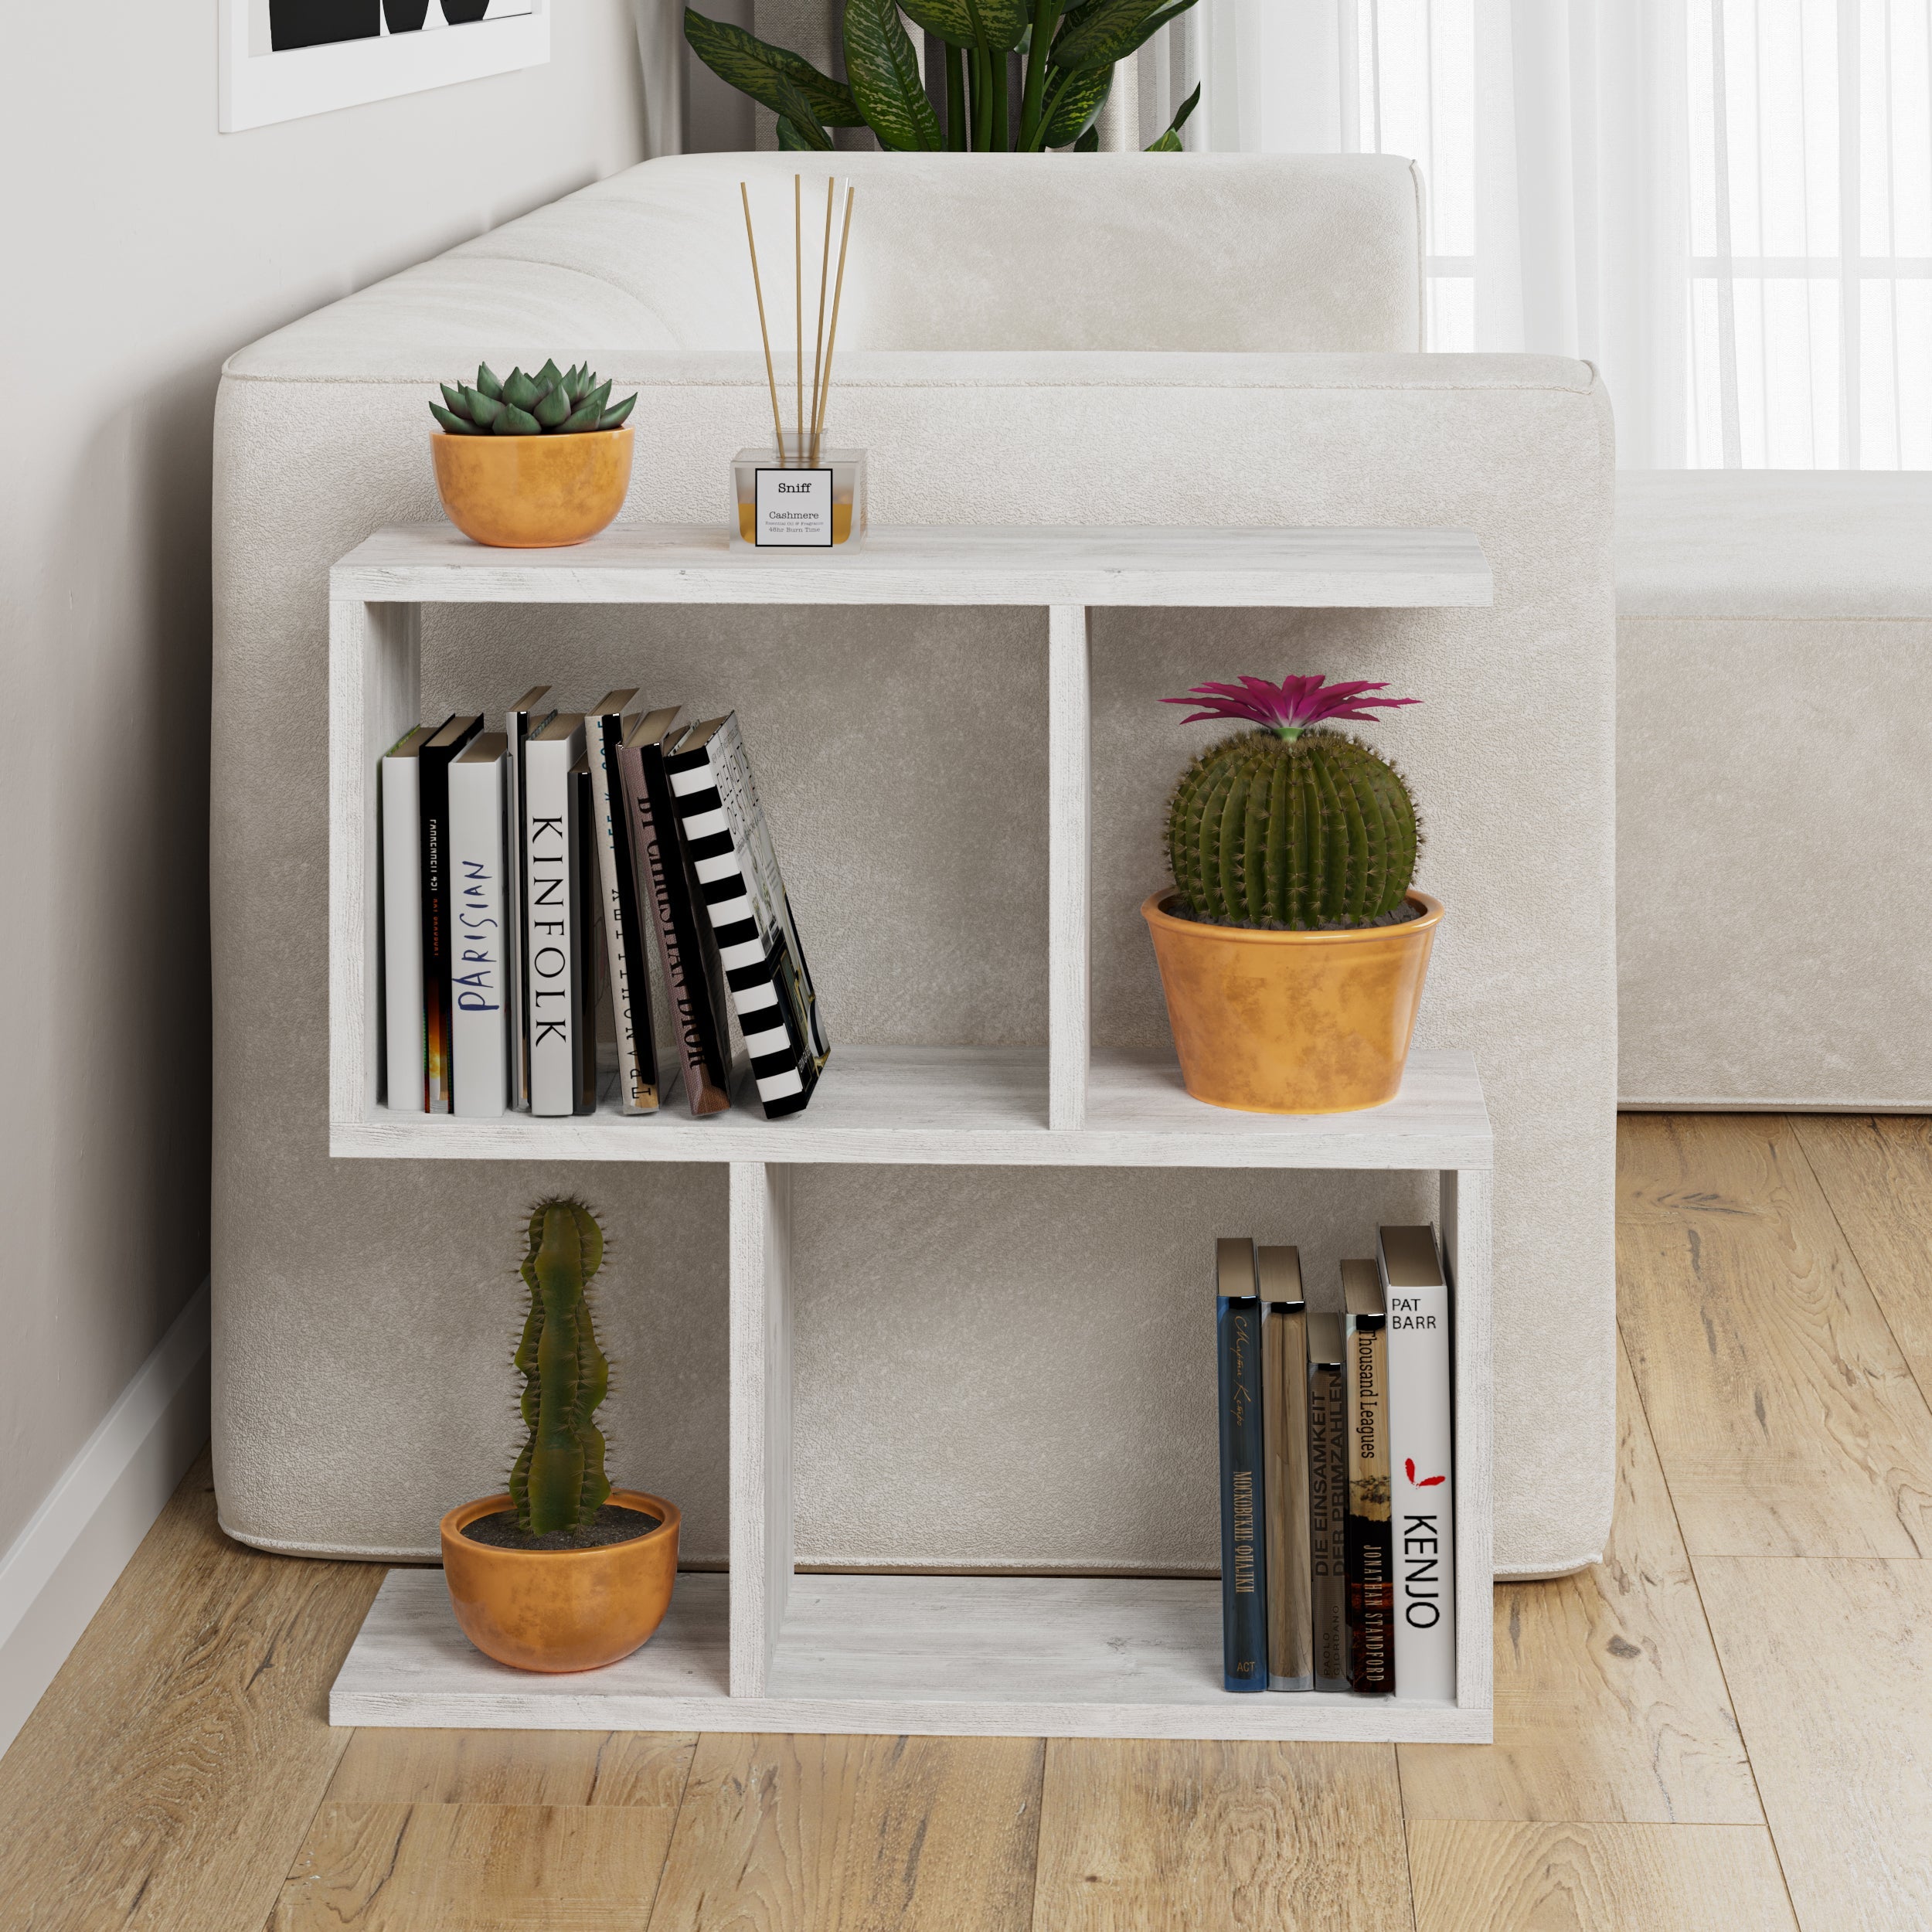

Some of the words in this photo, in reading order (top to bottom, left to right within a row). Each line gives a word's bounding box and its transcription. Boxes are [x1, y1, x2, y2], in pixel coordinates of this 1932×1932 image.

[769, 511, 819, 519] Cashmere
[778, 482, 812, 493] Sniff
[451, 860, 499, 1012] PARISIAN
[532, 815, 566, 1047] KINFOLK
[1392, 1298, 1421, 1311] PAT
[1392, 1315, 1437, 1330] BARR
[1358, 1329, 1379, 1398] Thousand
[1311, 1391, 1328, 1532] EINSAMKEIT
[1328, 1372, 1345, 1522] PRIMZAHLEN
[1356, 1401, 1378, 1459] Leagues
[1233, 1471, 1253, 1542] МОСКОВСКИЕ
[1234, 1545, 1255, 1593] ФИАЛКИ
[1315, 1539, 1329, 1577] DIE
[1332, 1529, 1345, 1577] DER
[1363, 1544, 1383, 1607] JONATHAN
[1403, 1515, 1440, 1629] KENJO
[1322, 1632, 1331, 1675] PAOLO
[1332, 1605, 1340, 1675] GIORDANO
[1365, 1613, 1385, 1682] STANDFORD
